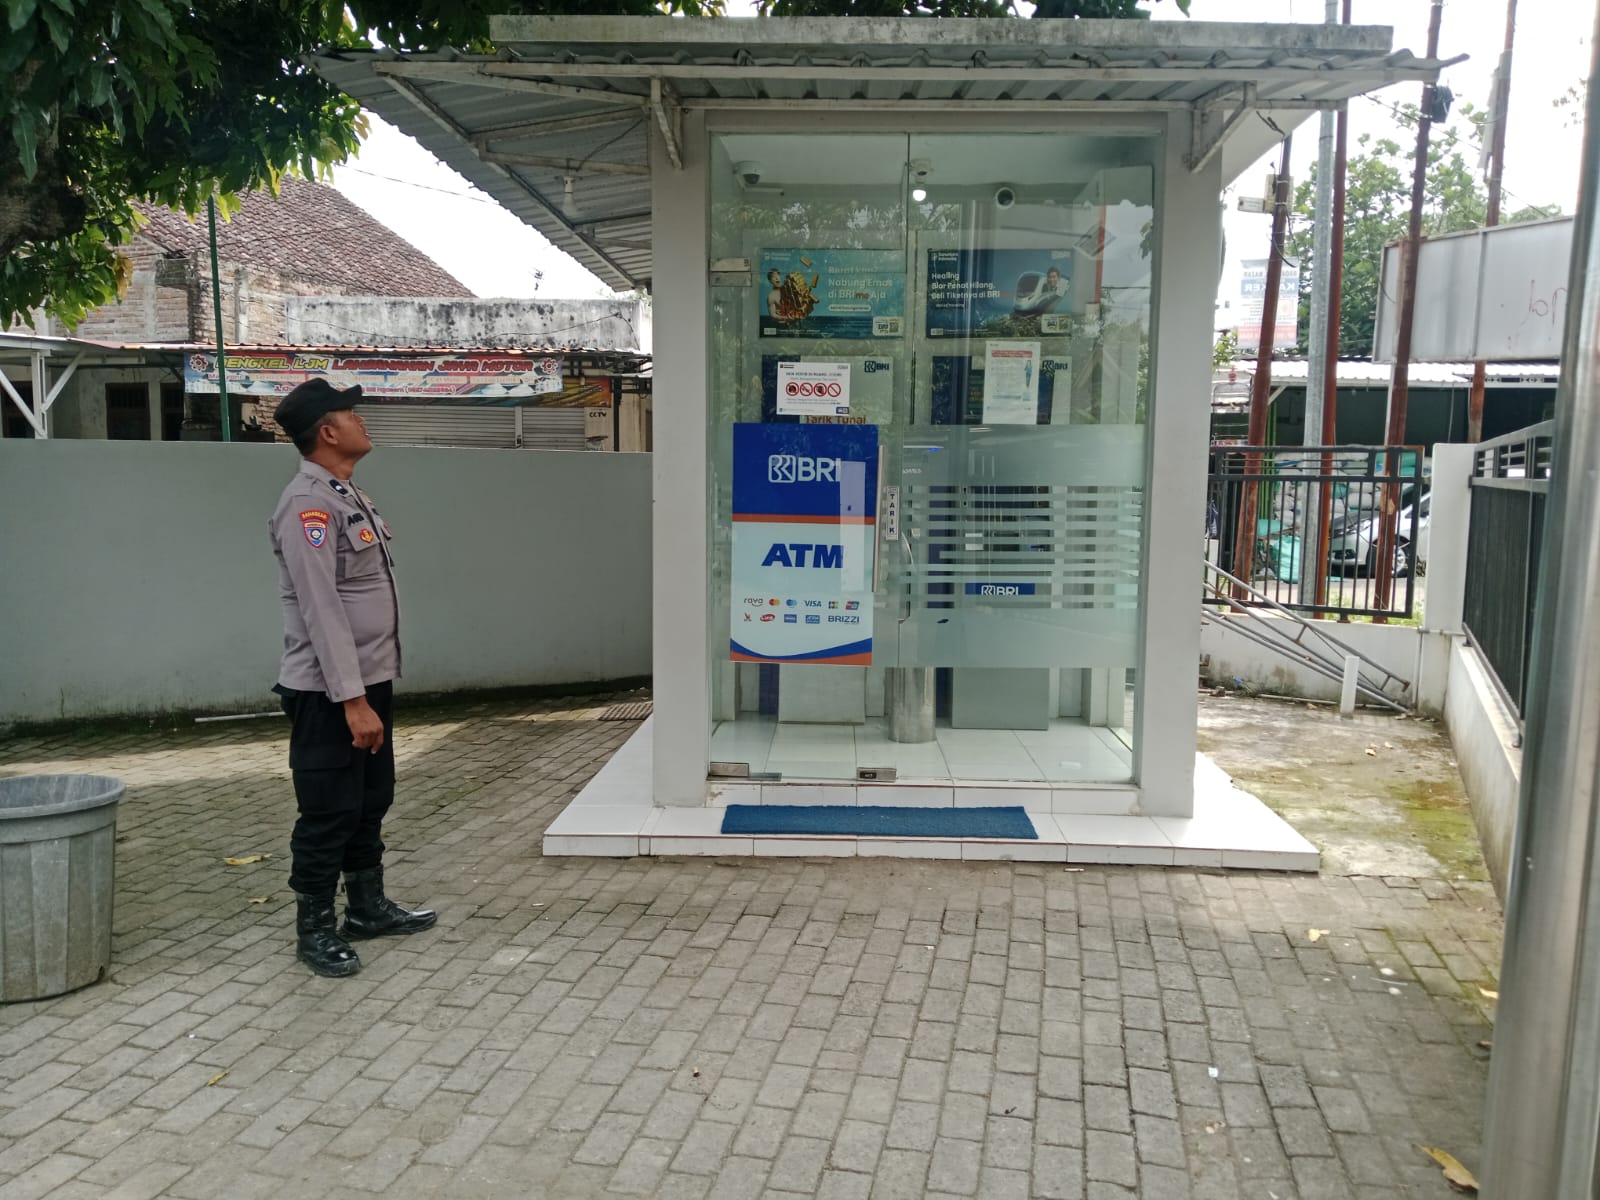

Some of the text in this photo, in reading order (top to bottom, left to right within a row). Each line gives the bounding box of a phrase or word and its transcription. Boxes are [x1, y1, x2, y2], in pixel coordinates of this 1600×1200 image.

[931, 272, 960, 281] Healing
[828, 279, 866, 289] Nabung
[481, 361, 534, 372] MOTOR
[805, 415, 866, 424] Tarik Tunai
[797, 459, 841, 482] BRI
[888, 493, 897, 535] TARIK
[761, 543, 844, 569] ATM
[996, 586, 1019, 596] BRI
[827, 615, 860, 623] BRIZZI
